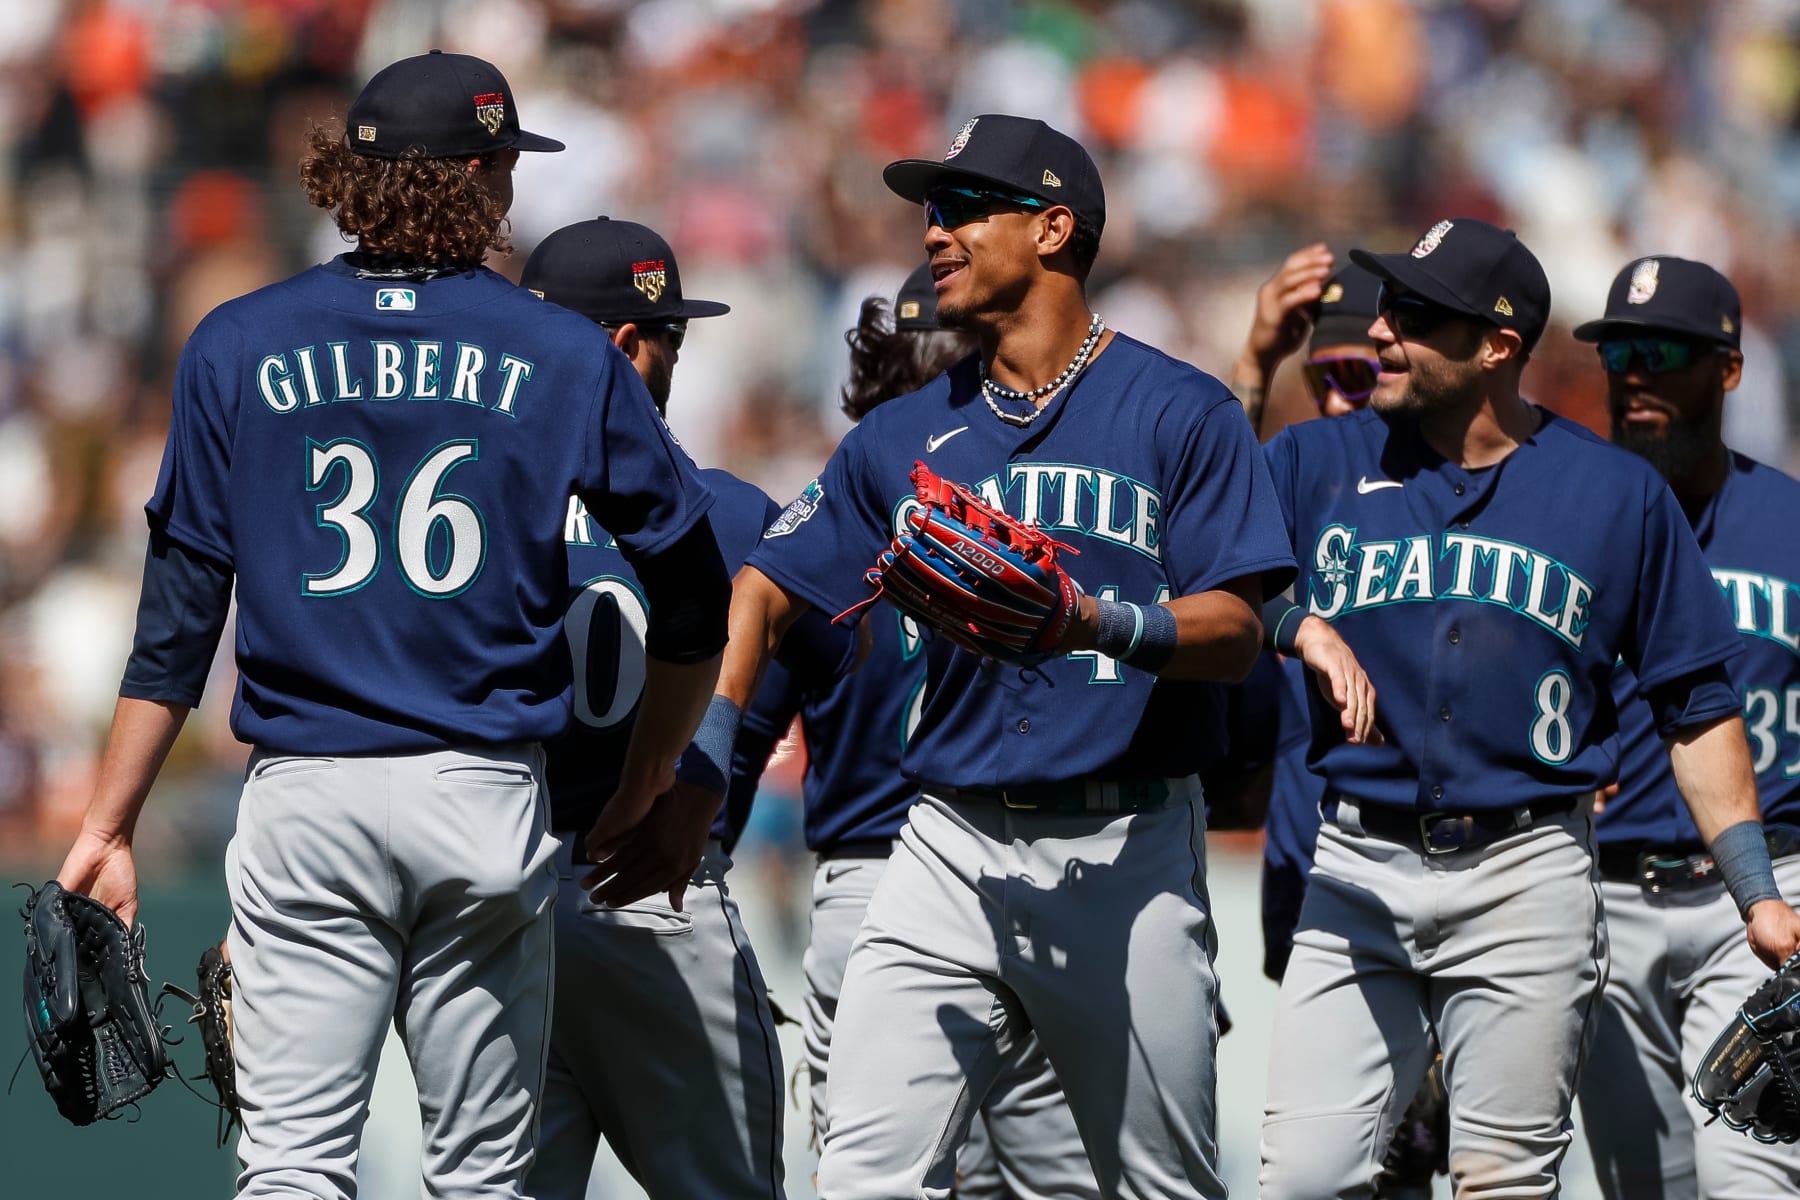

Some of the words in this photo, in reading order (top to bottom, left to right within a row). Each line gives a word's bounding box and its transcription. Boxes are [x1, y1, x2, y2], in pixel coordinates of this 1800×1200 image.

[256, 340, 534, 418] GILBERT
[301, 436, 487, 599] 36
[952, 540, 1006, 576] A2000
[1308, 523, 1596, 654] SEATTLE
[1529, 669, 1573, 765] 8
